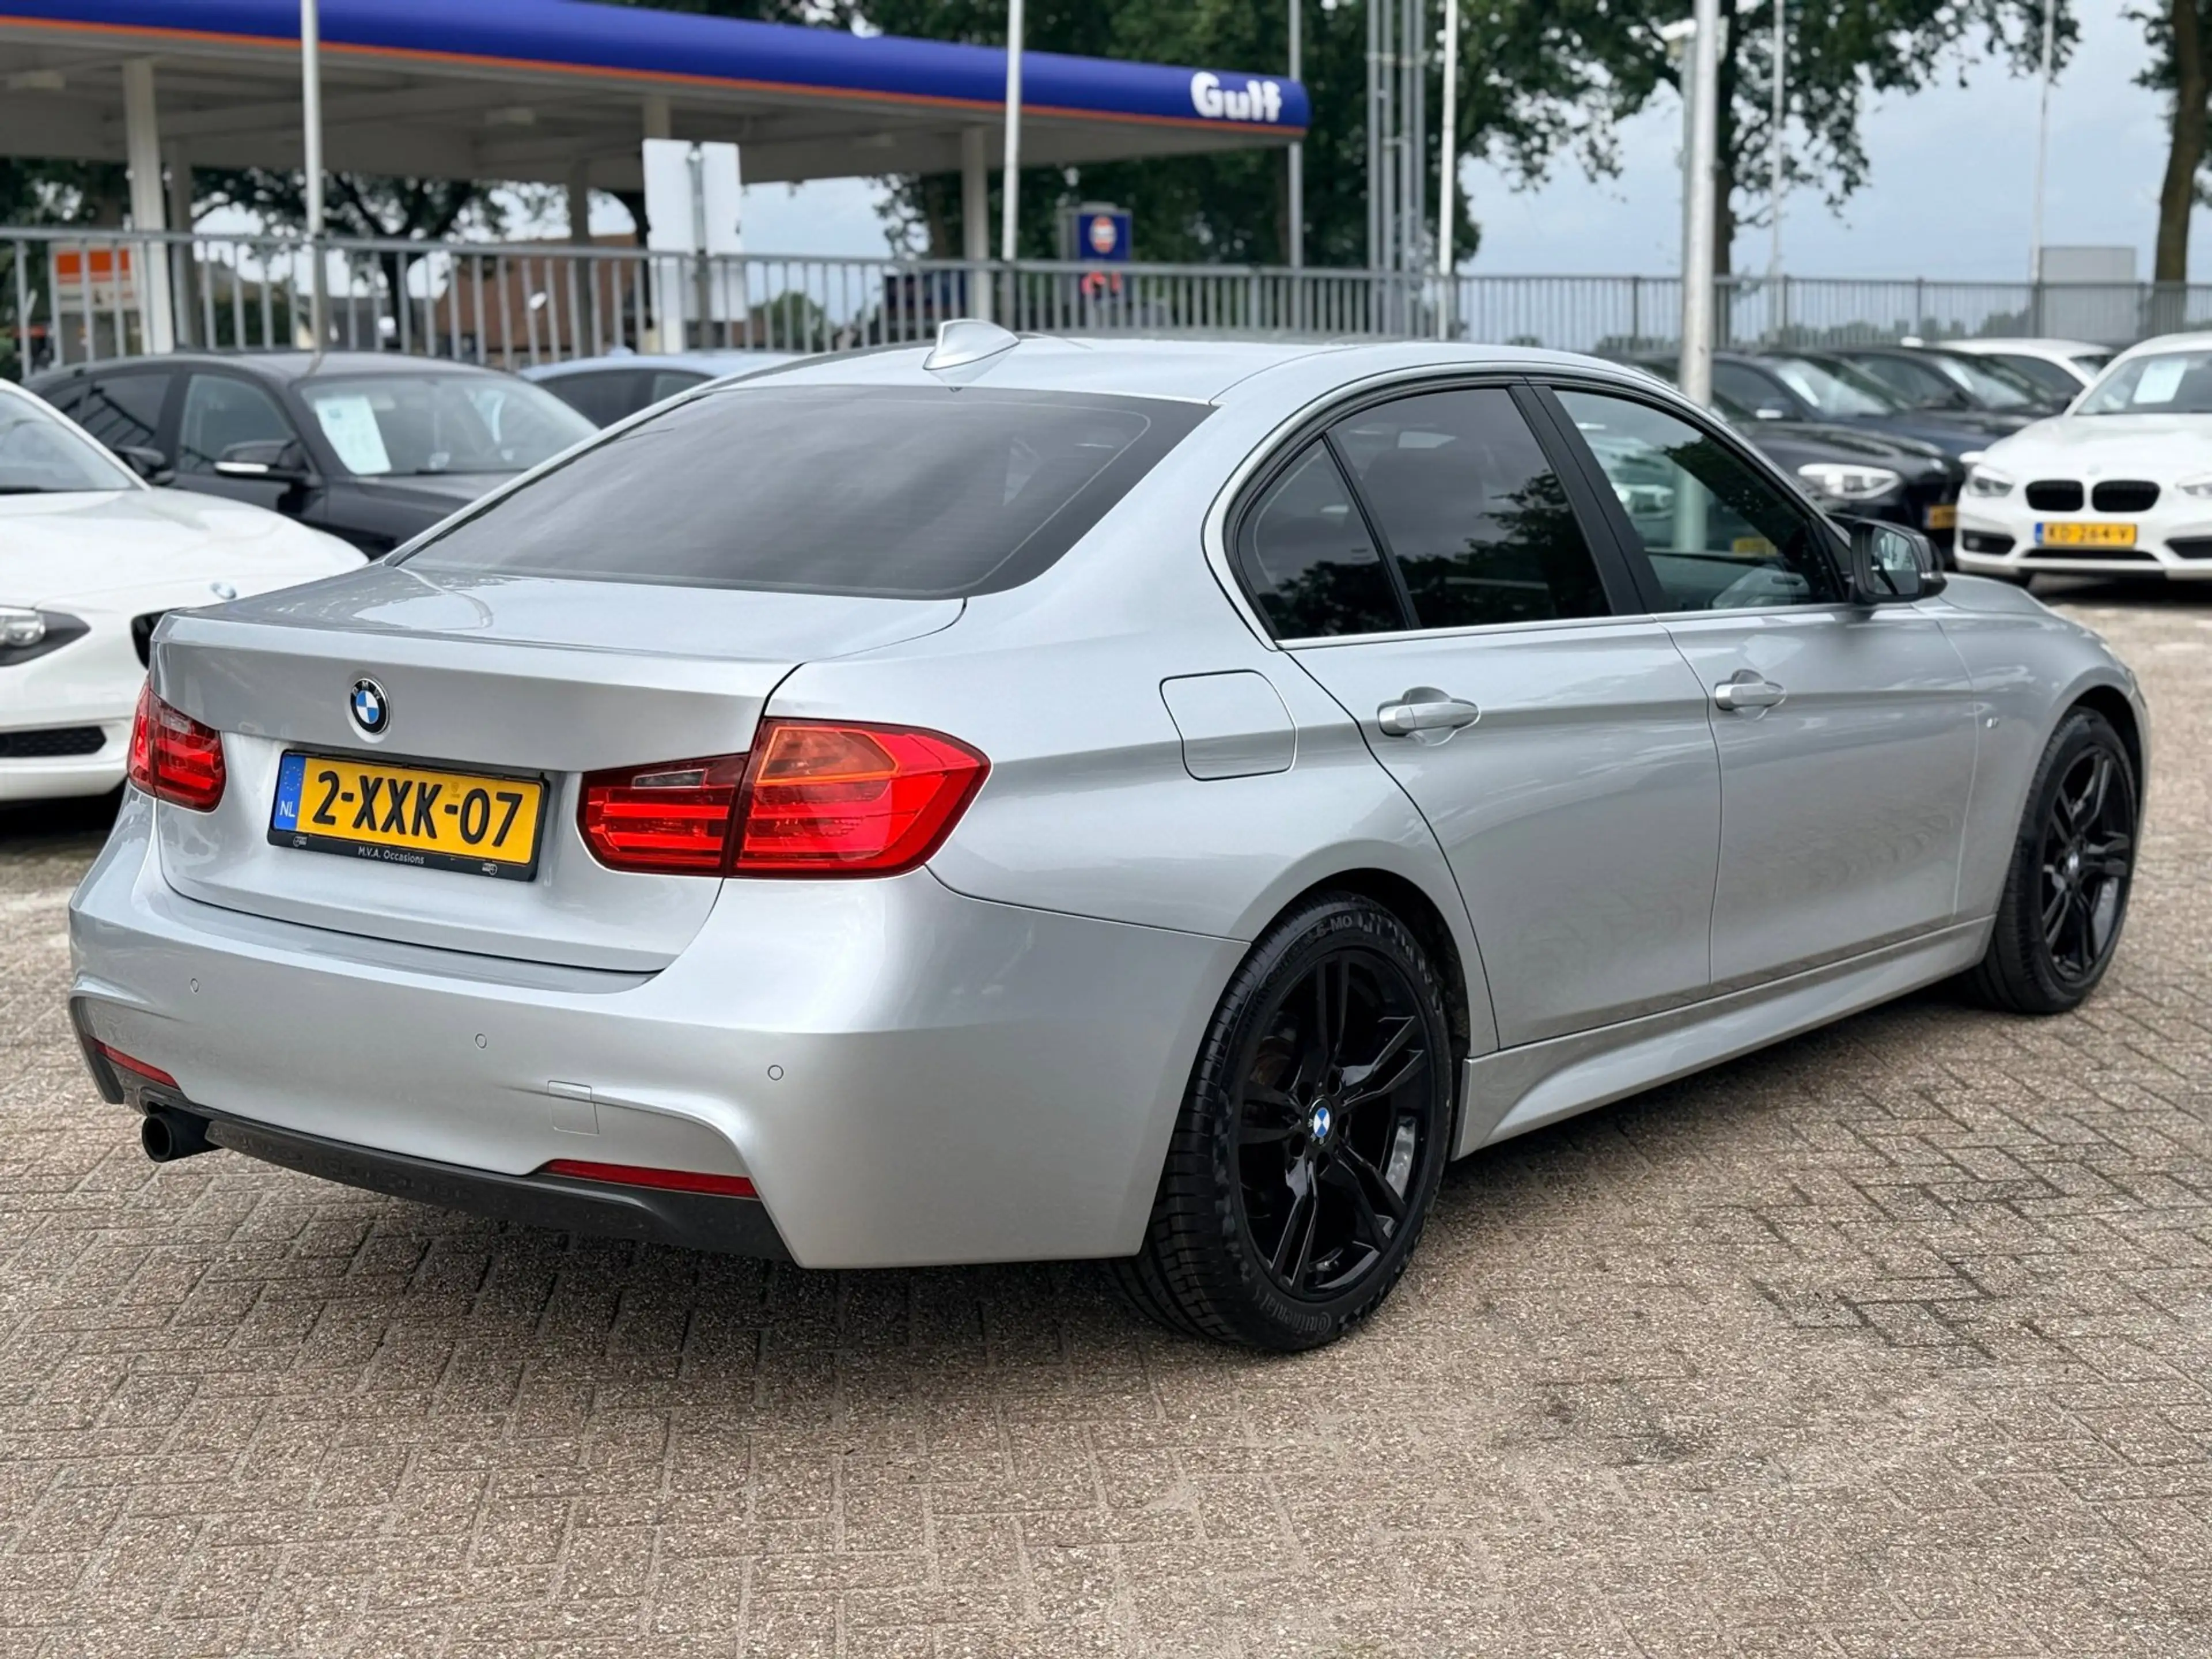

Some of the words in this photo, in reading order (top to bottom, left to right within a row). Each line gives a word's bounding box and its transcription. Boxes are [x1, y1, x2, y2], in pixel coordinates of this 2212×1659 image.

[1191, 71, 1282, 123] Gulf
[352, 680, 382, 700] BMW
[279, 800, 296, 817] NL
[312, 770, 523, 847] 2-XXK-07
[358, 845, 381, 858] M.V.A.
[383, 850, 425, 865] Occasions
